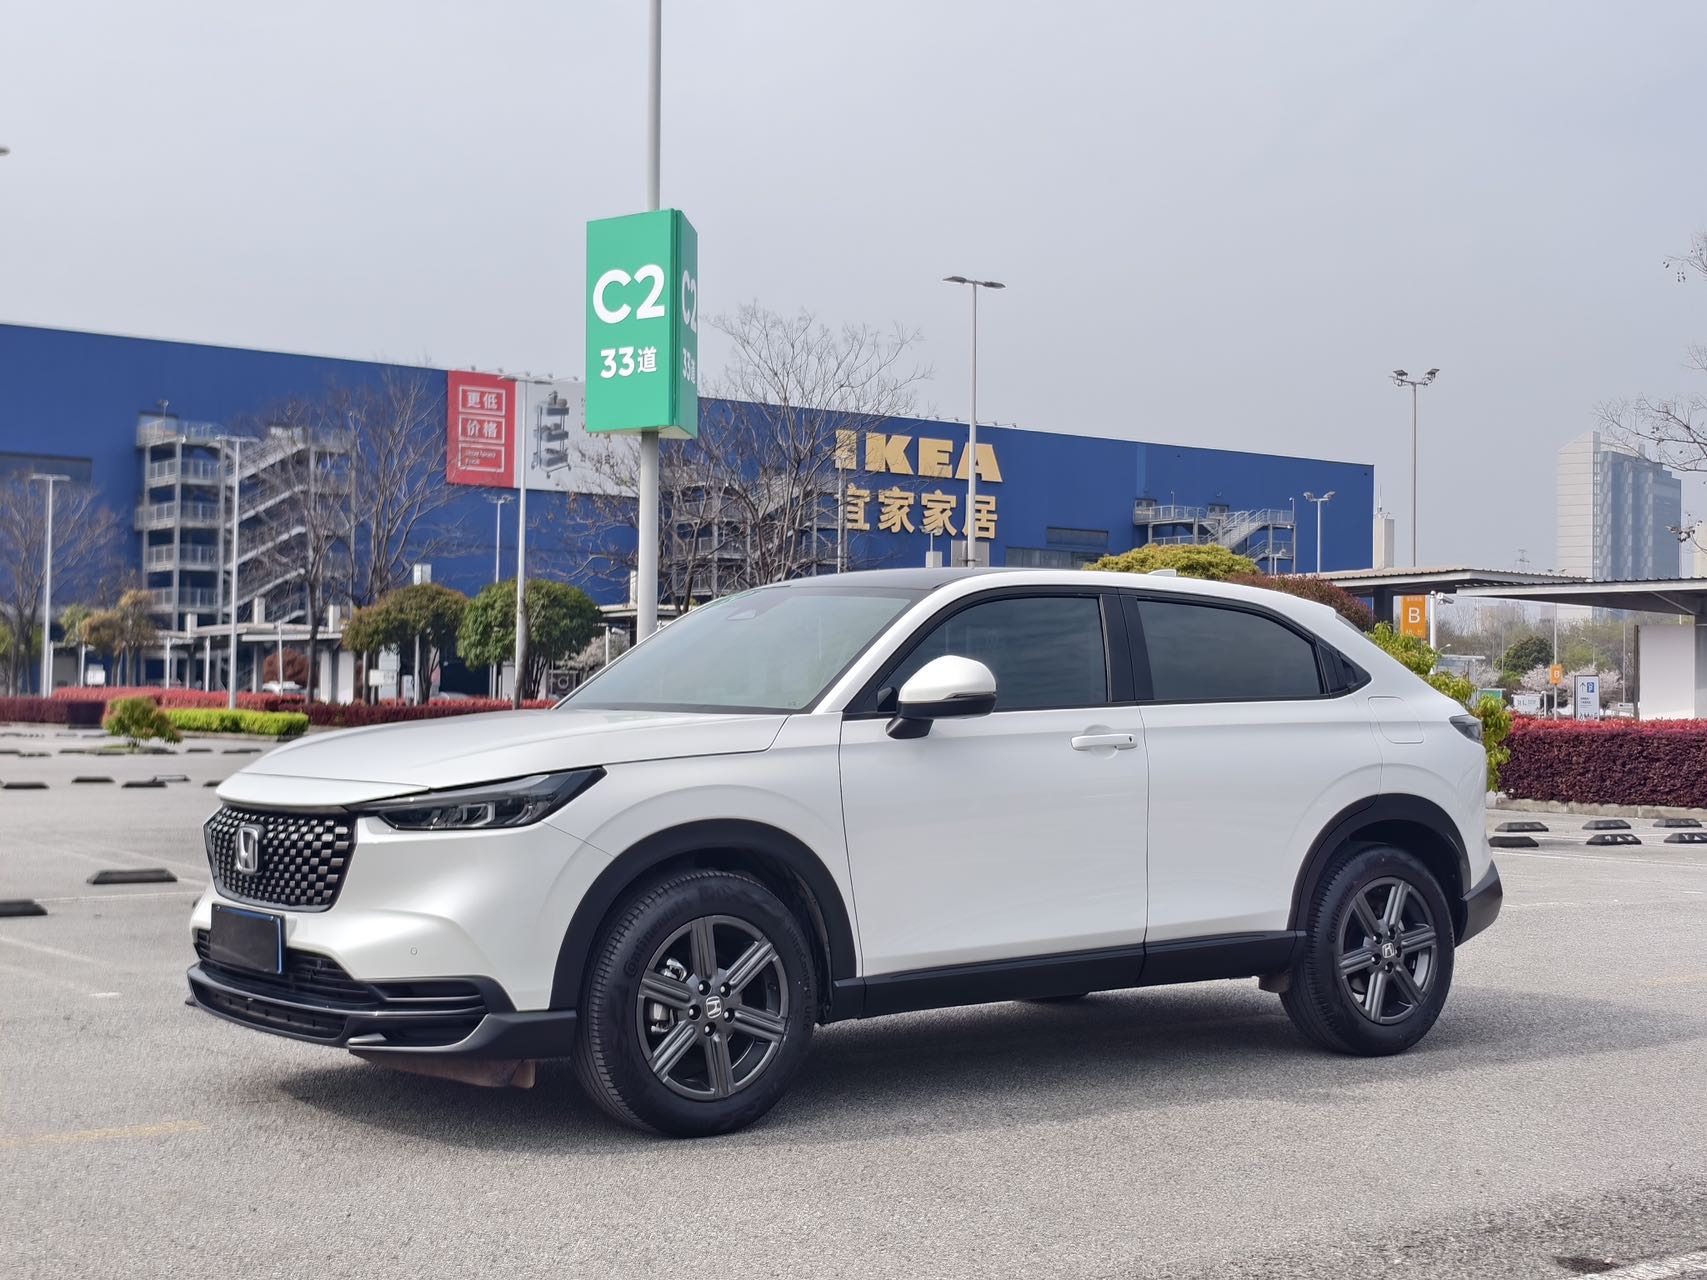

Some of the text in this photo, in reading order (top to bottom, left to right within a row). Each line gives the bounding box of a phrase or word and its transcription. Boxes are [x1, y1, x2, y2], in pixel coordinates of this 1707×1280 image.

[593, 264, 665, 324] C2
[682, 269, 697, 333] C2
[600, 346, 657, 378] 33道
[467, 391, 498, 409] 更低
[466, 419, 498, 438] 价格
[835, 430, 1003, 482] IKEA
[841, 482, 998, 539] 宜家家居
[1409, 607, 1421, 623] B
